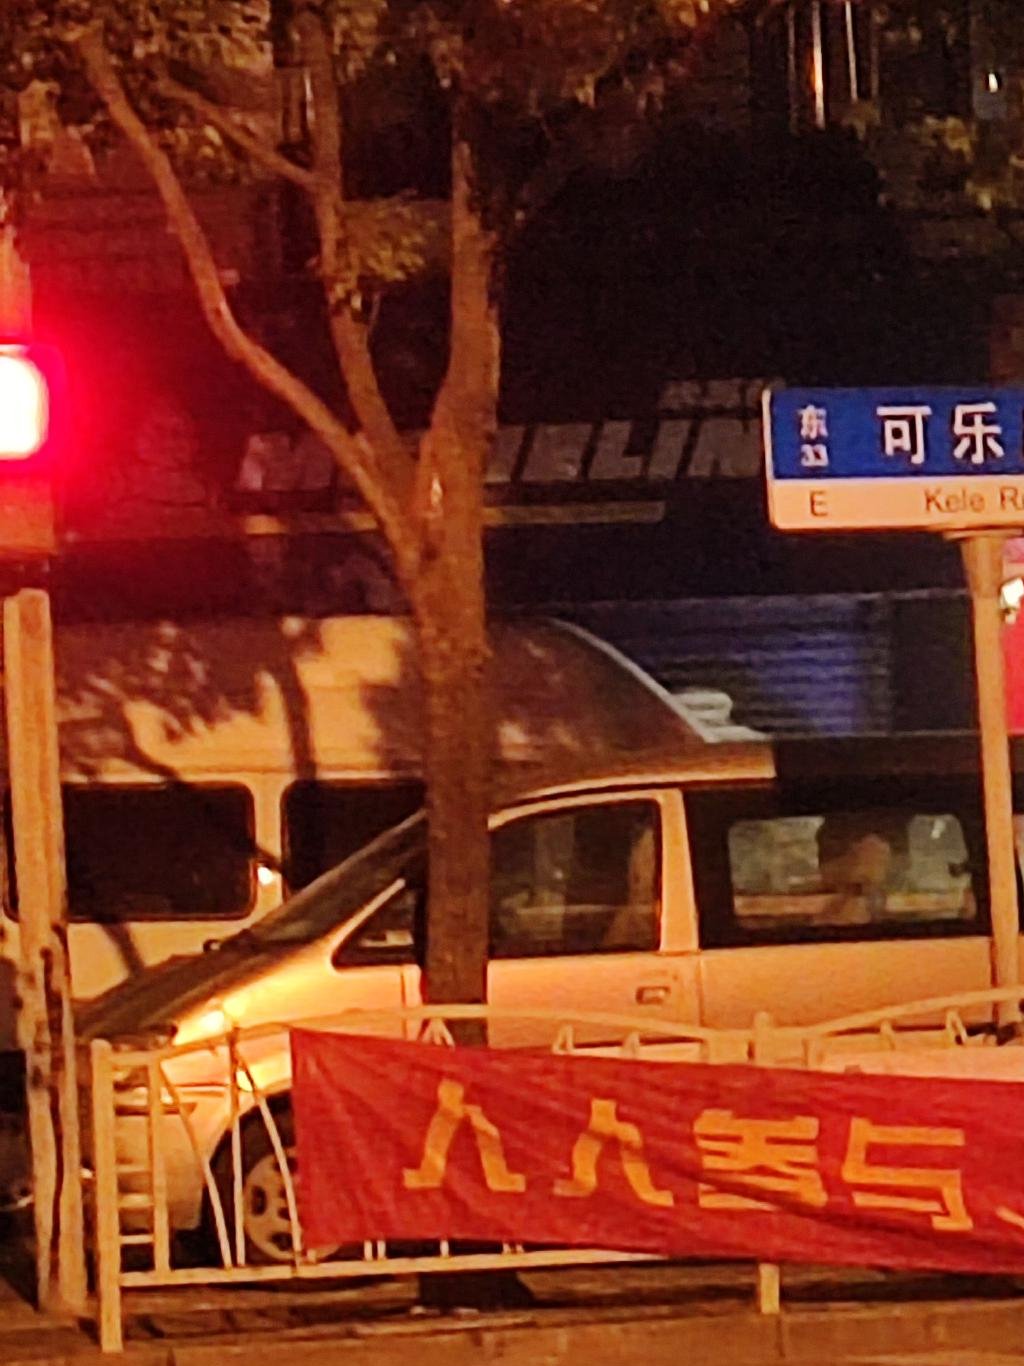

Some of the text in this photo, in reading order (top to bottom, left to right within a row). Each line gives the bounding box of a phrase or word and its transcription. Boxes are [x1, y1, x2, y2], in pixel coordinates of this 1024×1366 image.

[798, 404, 828, 438] 东
[809, 490, 828, 517] E
[924, 488, 985, 513] Kele
